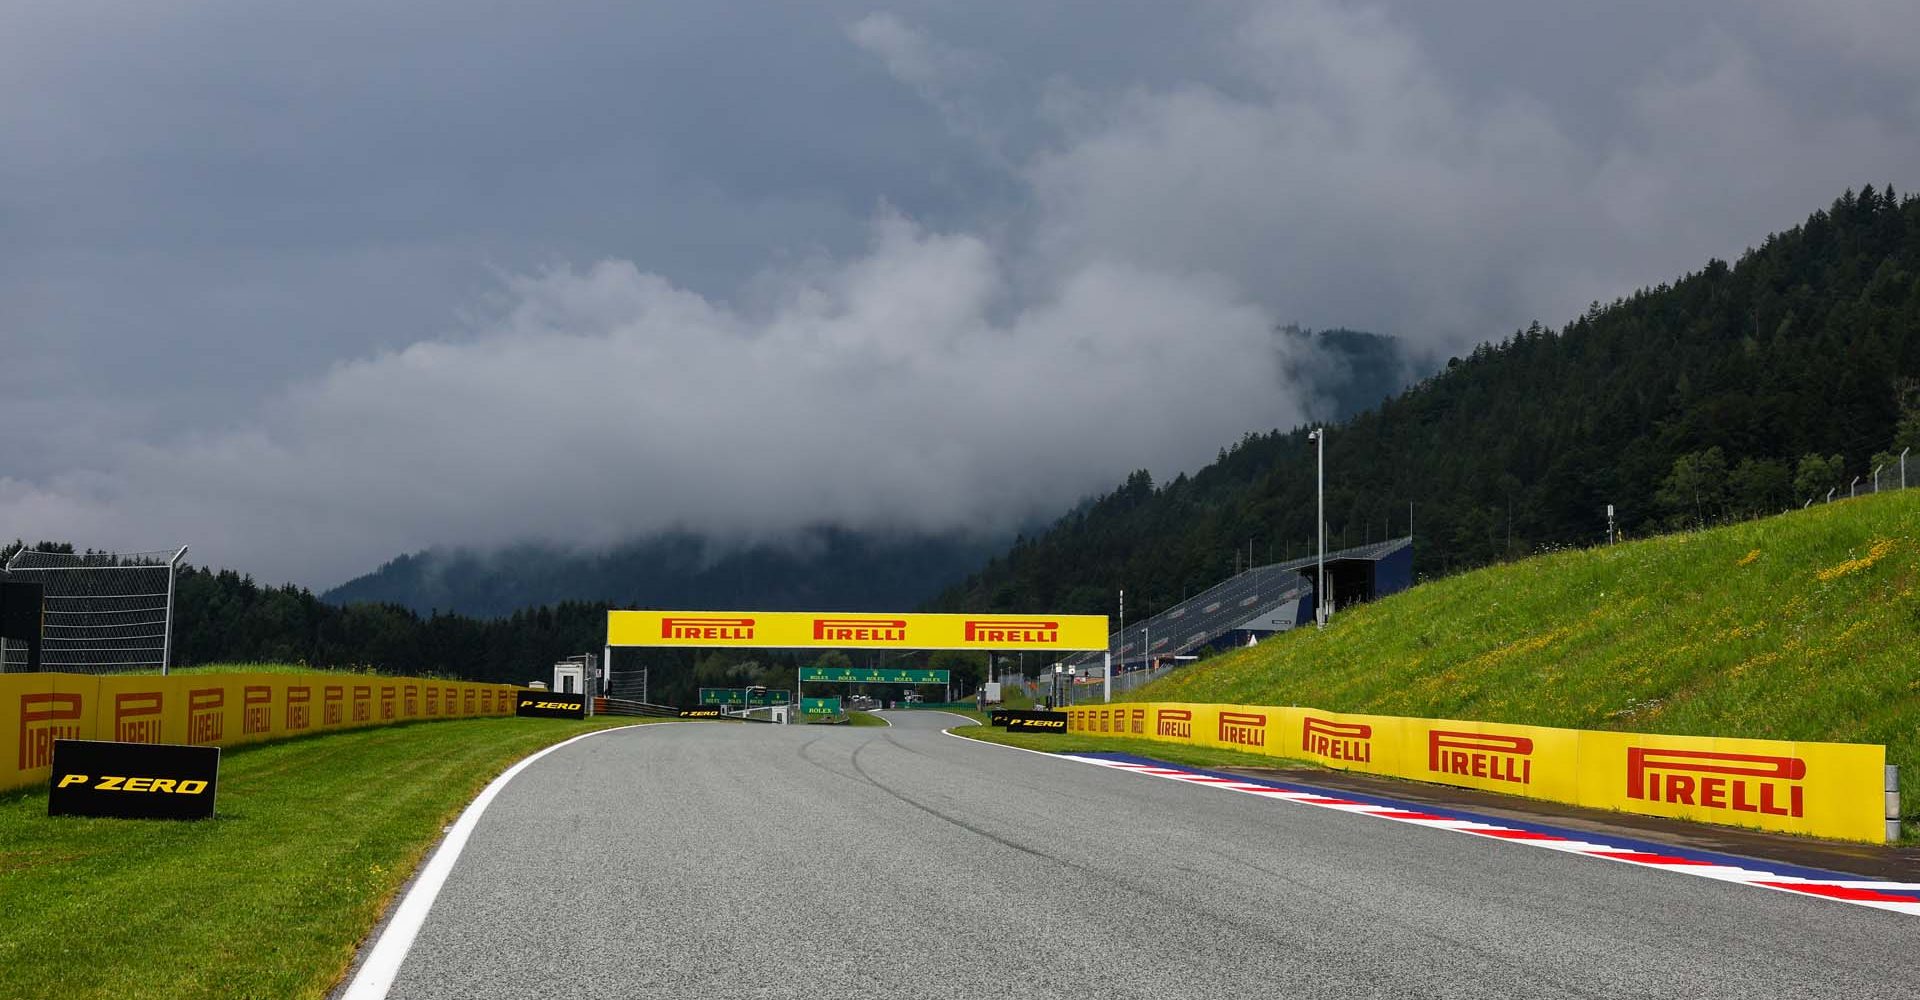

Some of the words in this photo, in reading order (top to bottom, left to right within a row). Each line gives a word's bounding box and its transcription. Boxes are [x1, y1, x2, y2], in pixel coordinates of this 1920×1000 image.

[661, 617, 755, 639] PIRELLI
[814, 619, 906, 641] PIRELLI
[965, 621, 1059, 643] PIRELLI
[188, 687, 225, 746] PIRELLI
[243, 686, 272, 735] PIRELLI
[286, 686, 312, 730] PIRELLI
[520, 700, 533, 708] P
[535, 701, 582, 711] ZERO
[1010, 718, 1021, 726] P
[1023, 719, 1065, 728] ZERO
[1157, 709, 1192, 739] PIRELLI
[1218, 711, 1266, 747] PIRELLI
[1302, 716, 1373, 763] PIRELLI
[1428, 729, 1534, 785] PIRELLI
[57, 774, 89, 789] P
[94, 775, 209, 795] ZERO
[1626, 746, 1807, 818] PIRELLI
